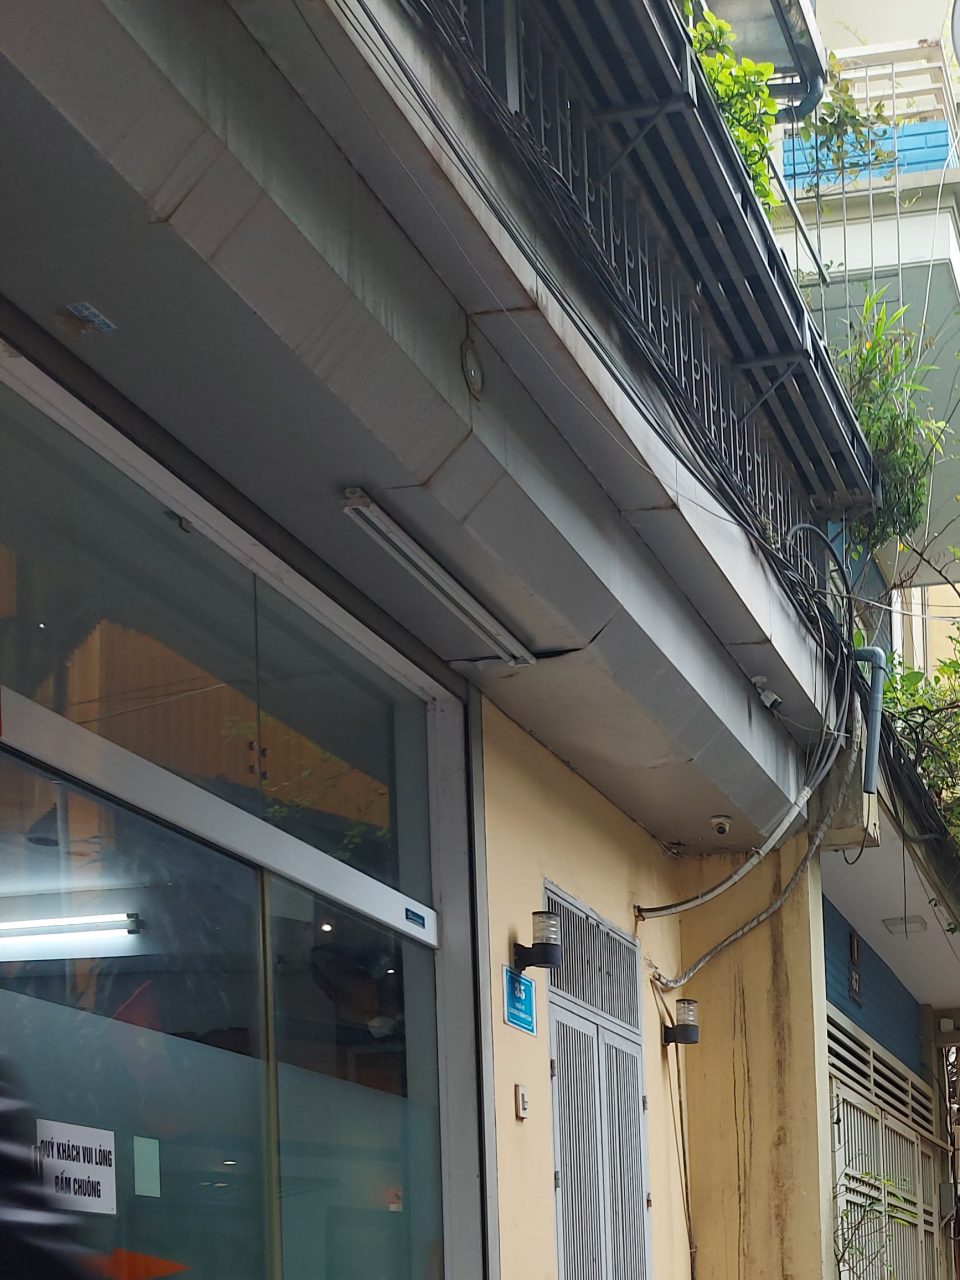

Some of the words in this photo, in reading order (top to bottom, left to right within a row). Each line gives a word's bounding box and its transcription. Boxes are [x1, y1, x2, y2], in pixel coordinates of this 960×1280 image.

[515, 982, 526, 1000] 35
[57, 1140, 81, 1163] KHÁCH
[82, 1146, 94, 1165] VUI
[95, 1144, 113, 1168] LÒNG
[54, 1170, 72, 1194] BẤM
[73, 1176, 101, 1198] CHUÔNG
